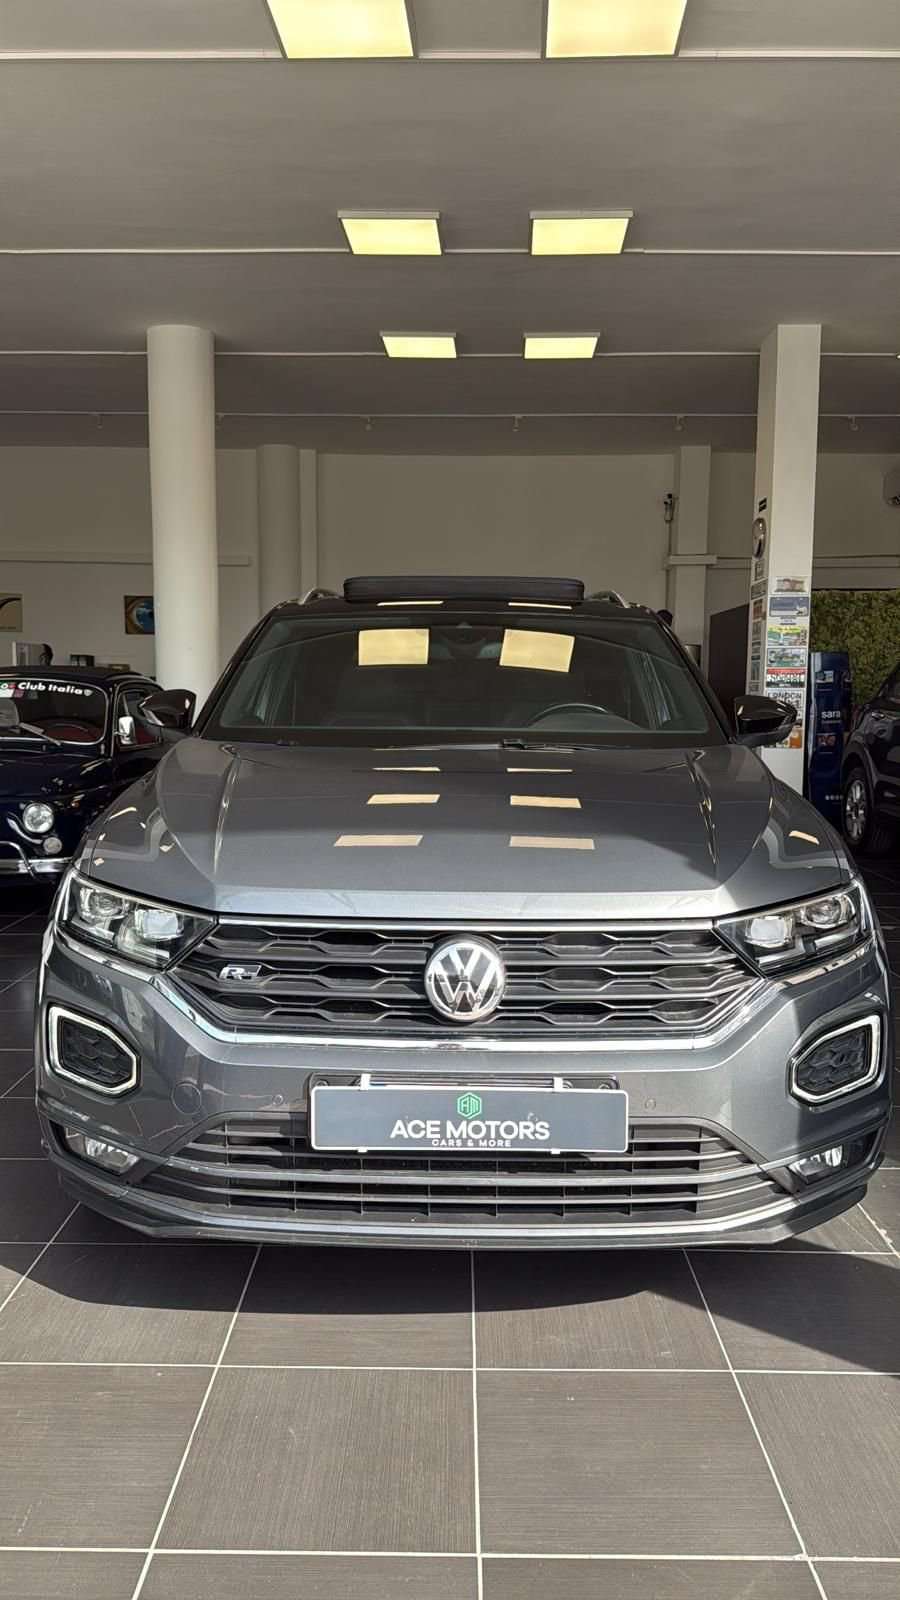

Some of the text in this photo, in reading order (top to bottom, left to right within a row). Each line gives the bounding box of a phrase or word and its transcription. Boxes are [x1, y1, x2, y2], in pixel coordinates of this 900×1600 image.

[18, 682, 46, 691] Club
[48, 684, 83, 695] Italia
[390, 1120, 550, 1140] ACE MOTORS
[431, 1139, 512, 1147] CARS & MORE
